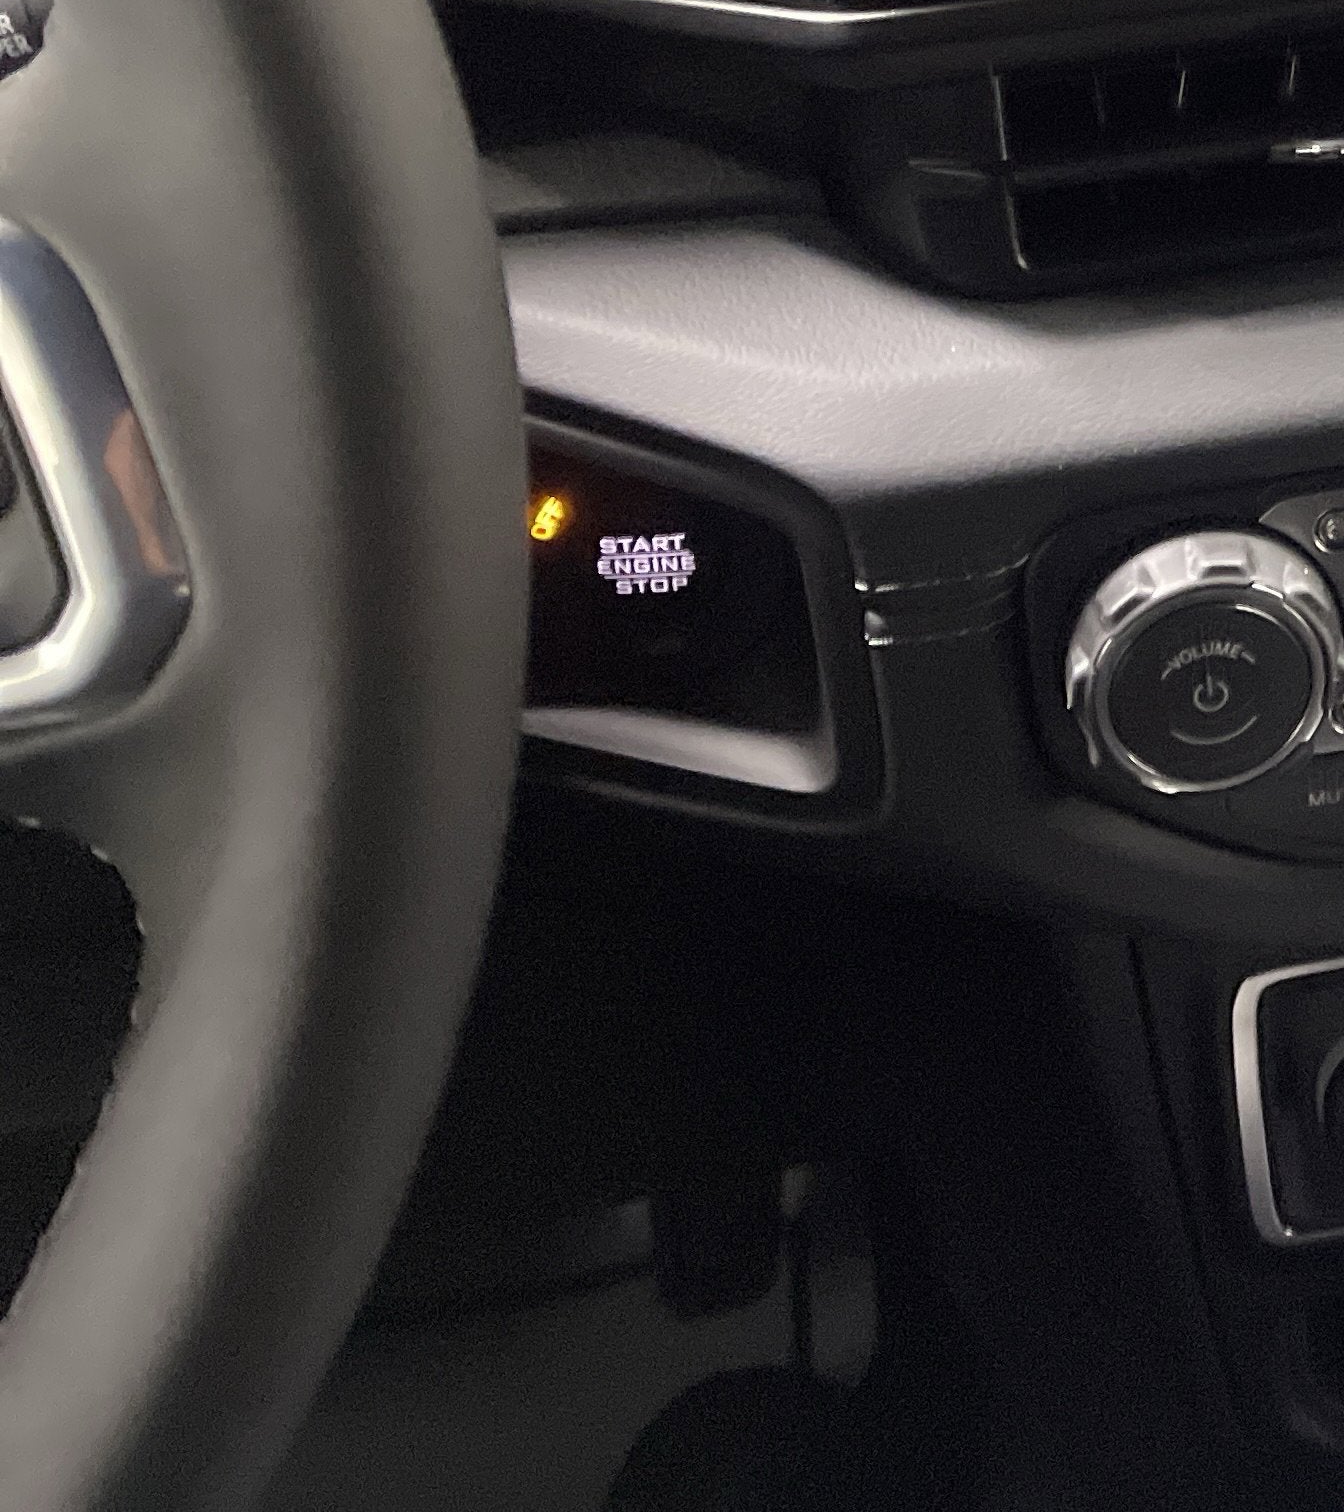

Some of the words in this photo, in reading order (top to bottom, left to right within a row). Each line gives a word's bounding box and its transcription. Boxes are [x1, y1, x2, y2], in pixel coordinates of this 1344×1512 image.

[599, 532, 686, 554] START
[597, 552, 696, 575] ENGINE
[616, 575, 689, 595] STOP
[1168, 640, 1242, 670] VOLUME
